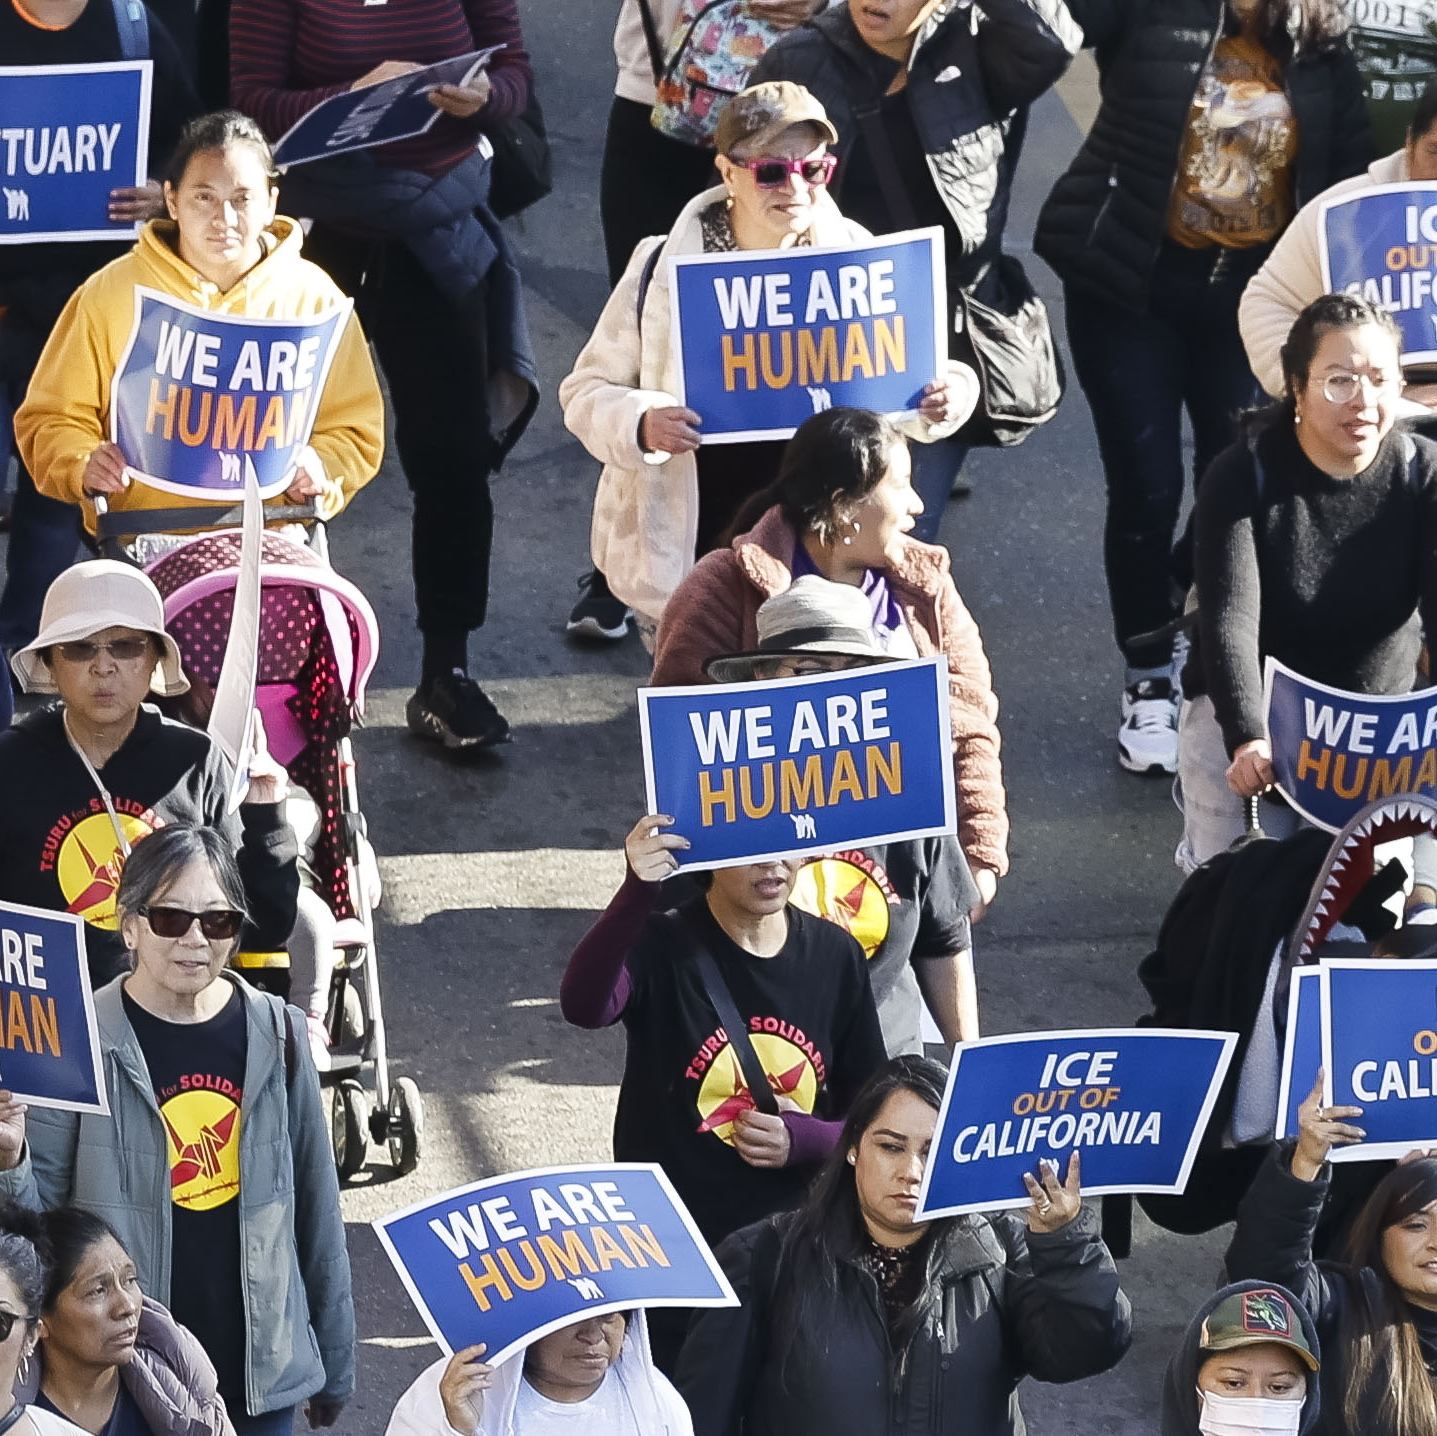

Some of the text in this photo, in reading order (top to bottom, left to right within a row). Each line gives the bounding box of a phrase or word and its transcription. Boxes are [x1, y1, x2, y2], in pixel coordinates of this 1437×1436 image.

[714, 260, 897, 330] WE ARE
[156, 324, 320, 391] WE ARE
[721, 316, 906, 392] HUMAN
[147, 378, 312, 451] HUMAN
[689, 688, 890, 765] WE ARE
[1304, 695, 1377, 755] WE
[698, 741, 902, 827] HUMAN
[40, 815, 71, 872] TSURU
[71, 808, 88, 819] for
[685, 1027, 728, 1080] TSURU
[1040, 1051, 1118, 1087] ICE
[180, 1073, 242, 1102] SOLIDA
[1013, 1087, 1120, 1115] OUT OF
[952, 1110, 1162, 1164] CALIFORNIA
[428, 1181, 637, 1259] WE ARE
[457, 1222, 672, 1312] HUMAN
